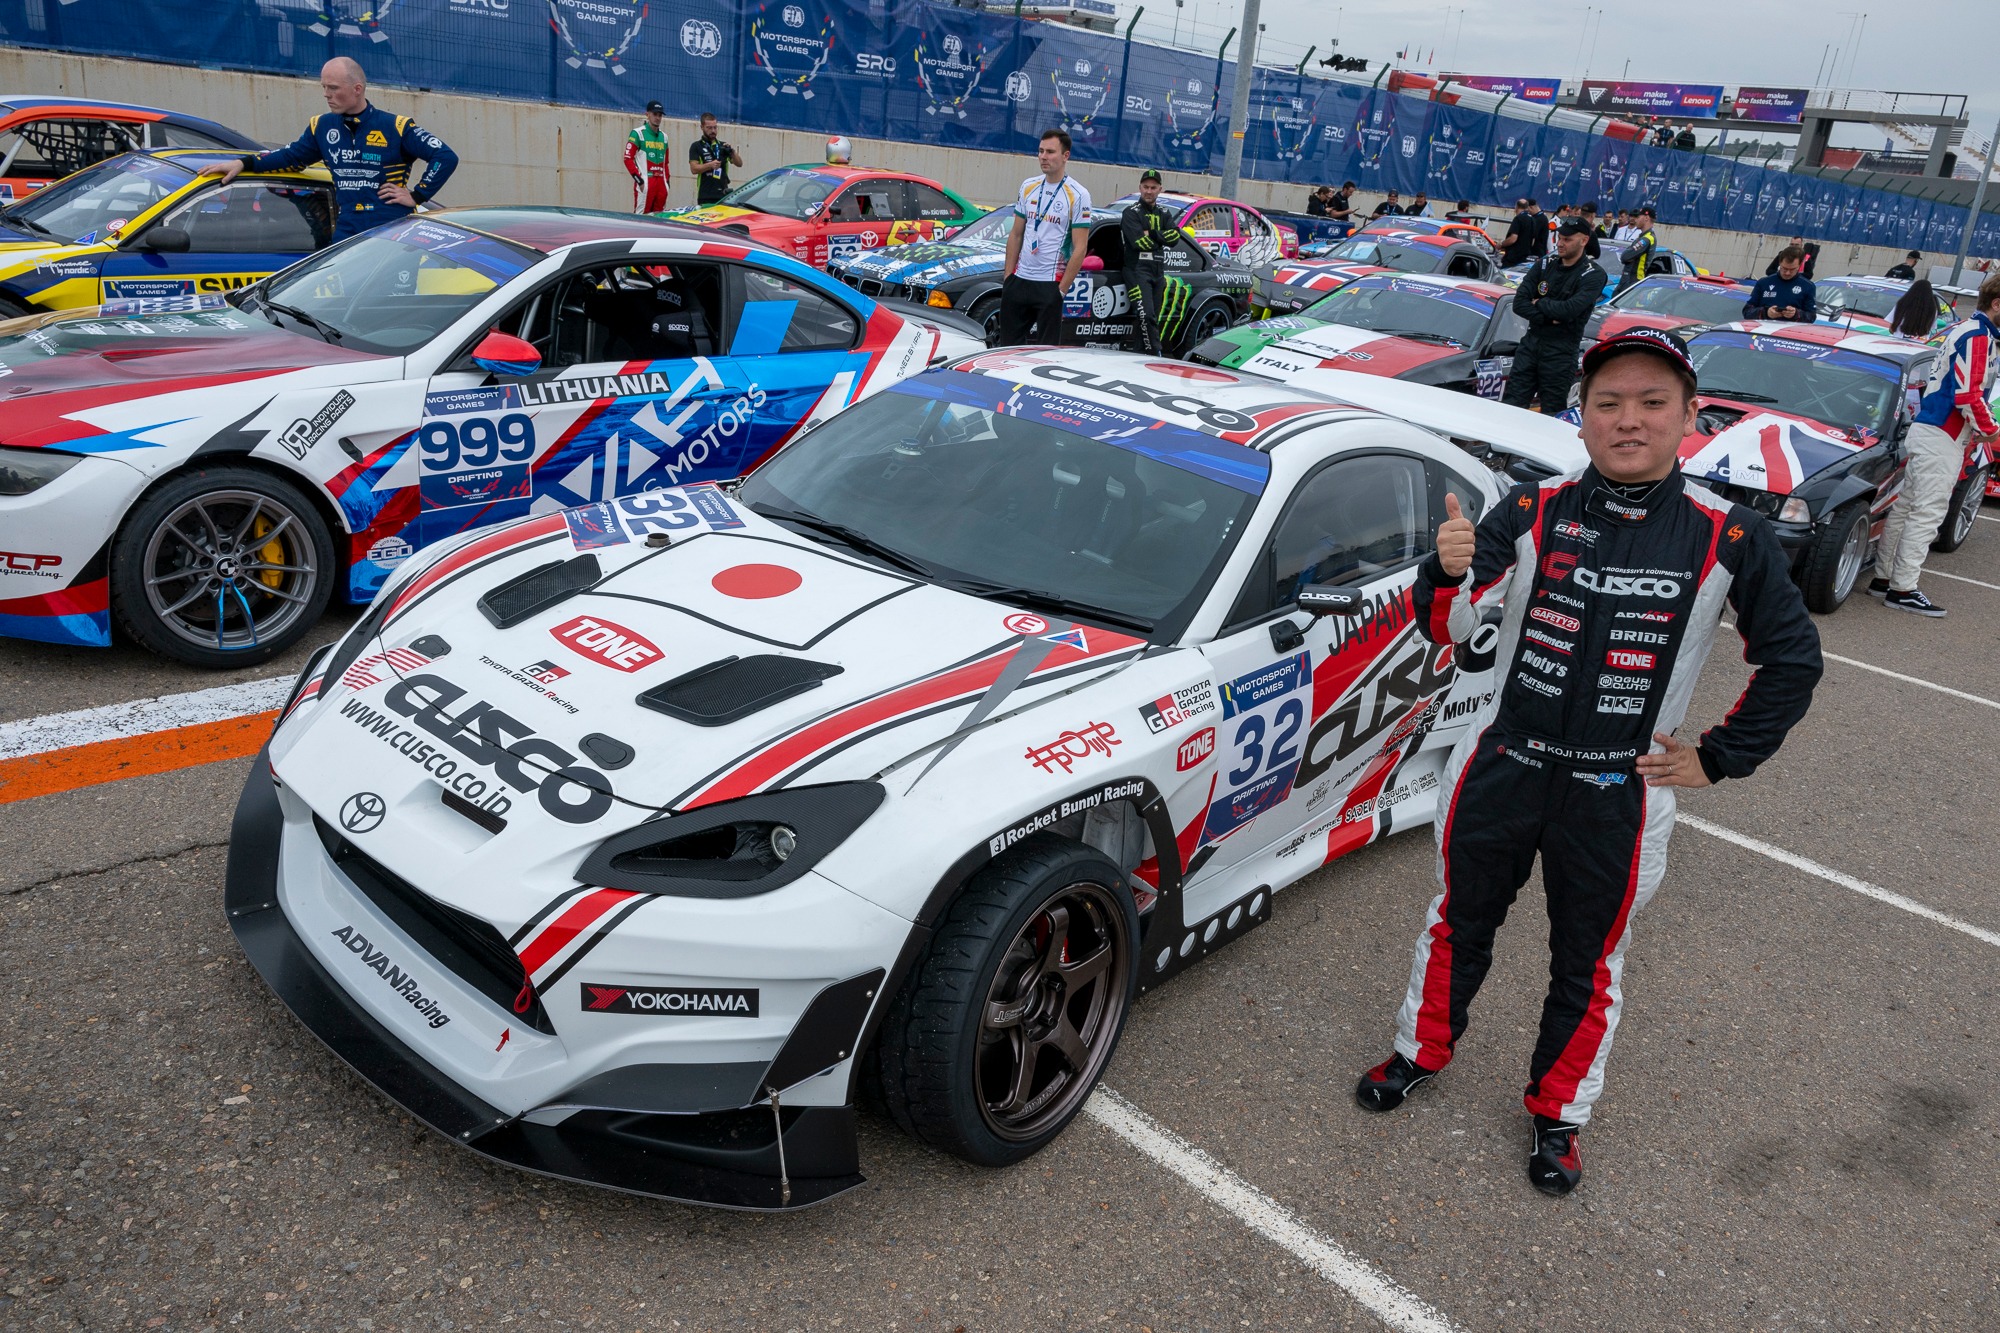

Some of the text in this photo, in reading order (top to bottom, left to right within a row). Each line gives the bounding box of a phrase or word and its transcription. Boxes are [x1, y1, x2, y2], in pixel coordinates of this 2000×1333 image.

[557, 0, 636, 17] MOTORSPORT
[576, 11, 617, 25] GAMES
[760, 32, 824, 48] MOTORSPORT
[775, 43, 809, 55] GAMES
[856, 53, 896, 72] SRO
[923, 58, 977, 73] MOTORSPORT
[935, 69, 965, 79] GAMES
[1058, 80, 1103, 93] MOTORSPORT
[1068, 89, 1092, 99] GAMES
[1491, 83, 1513, 91] makes
[1525, 88, 1551, 97] Lenovo
[1614, 89, 1668, 99] Smarter makes
[1126, 95, 1152, 111] SRO
[1172, 99, 1213, 111] MOTORSPORT
[1611, 96, 1674, 106] the fastest, faster
[1683, 96, 1712, 105] Lenovo
[1750, 97, 1773, 106] fastest,
[1774, 98, 1794, 106] faster
[1180, 107, 1201, 116] GAMES
[1324, 125, 1346, 138] SRO
[362, 152, 381, 162] NORTH
[1466, 151, 1486, 162] SRO
[417, 224, 466, 240] MOTORSPORT
[417, 231, 445, 241] GAMES
[1163, 251, 1187, 259] TURBO
[1169, 259, 1190, 267] Hellas
[24, 258, 92, 275] Performance
[64, 266, 90, 275] nordic
[856, 261, 899, 276] GREECE
[1397, 281, 1444, 292] MOTORSPORT
[1405, 285, 1431, 293] GAMES
[668, 323, 690, 332] sparco
[1761, 337, 1827, 352] MOTORSPORT
[1773, 343, 1808, 352] GAMES
[1254, 357, 1305, 373] ITALY
[523, 372, 670, 406] LITHUANIA
[426, 391, 499, 404] MOTORSPORT
[446, 401, 485, 410] GAMES
[1030, 364, 1256, 432] CUSCO
[311, 391, 348, 428] INDIVIDUAL
[1025, 390, 1140, 425] MOTORSPORT
[1041, 402, 1102, 424] GAMES
[307, 396, 354, 444] RACING PARTS
[1041, 412, 1083, 427] 2024
[665, 382, 768, 485] MOTORS
[419, 413, 536, 471] 999
[447, 470, 503, 484] DRIFTING
[619, 493, 700, 536] 32
[698, 499, 715, 515] GAMES
[703, 492, 733, 521] MOTORSPORT
[1604, 500, 1648, 517] Silverstone
[1554, 523, 1580, 537] GR
[1645, 568, 1683, 578] EQUIPMENT
[1573, 567, 1681, 599] CUSCO
[1298, 592, 1352, 603] CUSCO
[1548, 591, 1585, 610] YOKOHAMA
[1328, 584, 1408, 657] JAPAN
[1533, 609, 1578, 629] SAFETY21
[1614, 611, 1669, 623] ADVAN
[561, 619, 658, 669] TONE
[1610, 629, 1669, 645] BRIDE
[1611, 652, 1653, 667] TONE
[520, 663, 563, 684] GR
[1236, 663, 1296, 695] MOTORSPORT
[478, 654, 580, 715] TOYOTA GAZOO Racing
[1173, 679, 1211, 700] TOYOTA
[1252, 680, 1284, 700] GAMES
[1517, 671, 1563, 697] FUJITSUBO
[1178, 690, 1212, 710] GAZOO
[1599, 697, 1643, 713] HKS
[1182, 700, 1216, 720] Racing
[1147, 707, 1183, 733] GR
[384, 673, 614, 824] CUSCO
[1179, 730, 1214, 768] TONE
[1228, 697, 1304, 788] 32
[339, 698, 513, 818] www.cusco.co.jp
[1547, 745, 1637, 761] KOJI TADA RH+O
[1572, 771, 1628, 785] FACTORY BASE
[1231, 775, 1278, 805] DRIFTING
[1385, 785, 1409, 801] OGURA
[1386, 792, 1411, 809] CLUTCH
[1006, 780, 1144, 846] Rocket Bunny Racing
[1309, 816, 1342, 838] NAPREC
[625, 991, 750, 1012] YOKOHAMA
